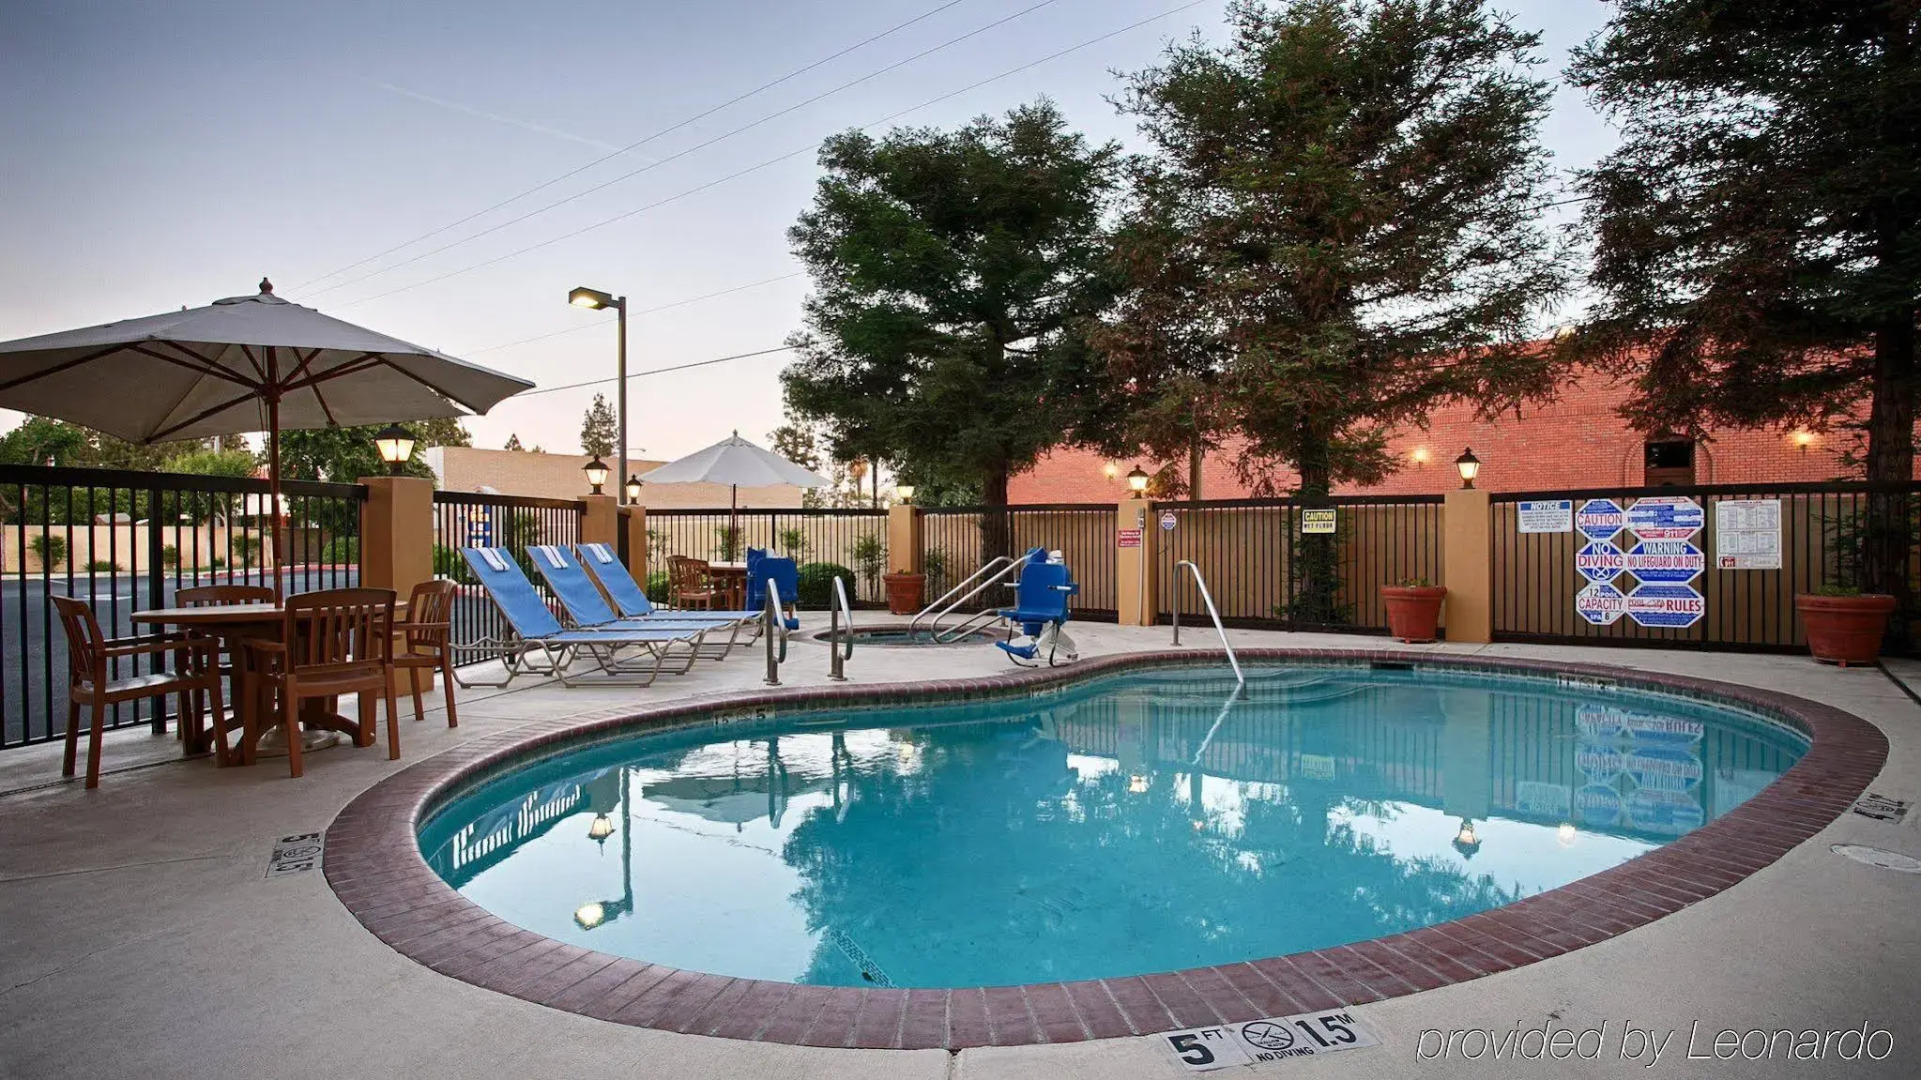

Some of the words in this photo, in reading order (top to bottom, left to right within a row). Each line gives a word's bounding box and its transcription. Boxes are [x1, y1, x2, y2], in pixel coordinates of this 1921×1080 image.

[1531, 502, 1561, 511] NOTICE
[1305, 511, 1334, 521] CAUTION
[1577, 514, 1622, 525] CAUTION
[1592, 543, 1611, 554] NO
[1643, 542, 1687, 554] WARNING
[1578, 555, 1623, 567] DIVING
[1627, 555, 1637, 567] NO
[1640, 555, 1672, 567] LIFEGUARD
[1673, 555, 1684, 567] ON
[1685, 555, 1702, 567] DUTY
[1589, 588, 1599, 597] 12
[1578, 599, 1623, 610] CAPACITY
[1666, 600, 1702, 611] RULES
[1168, 1033, 1215, 1066] 5
[1200, 1028, 1224, 1041] FT
[1294, 1016, 1357, 1048] 1.5
[1335, 1013, 1356, 1025] M
[1256, 1052, 1275, 1062] NO
[1274, 1046, 1315, 1060] DIVING
